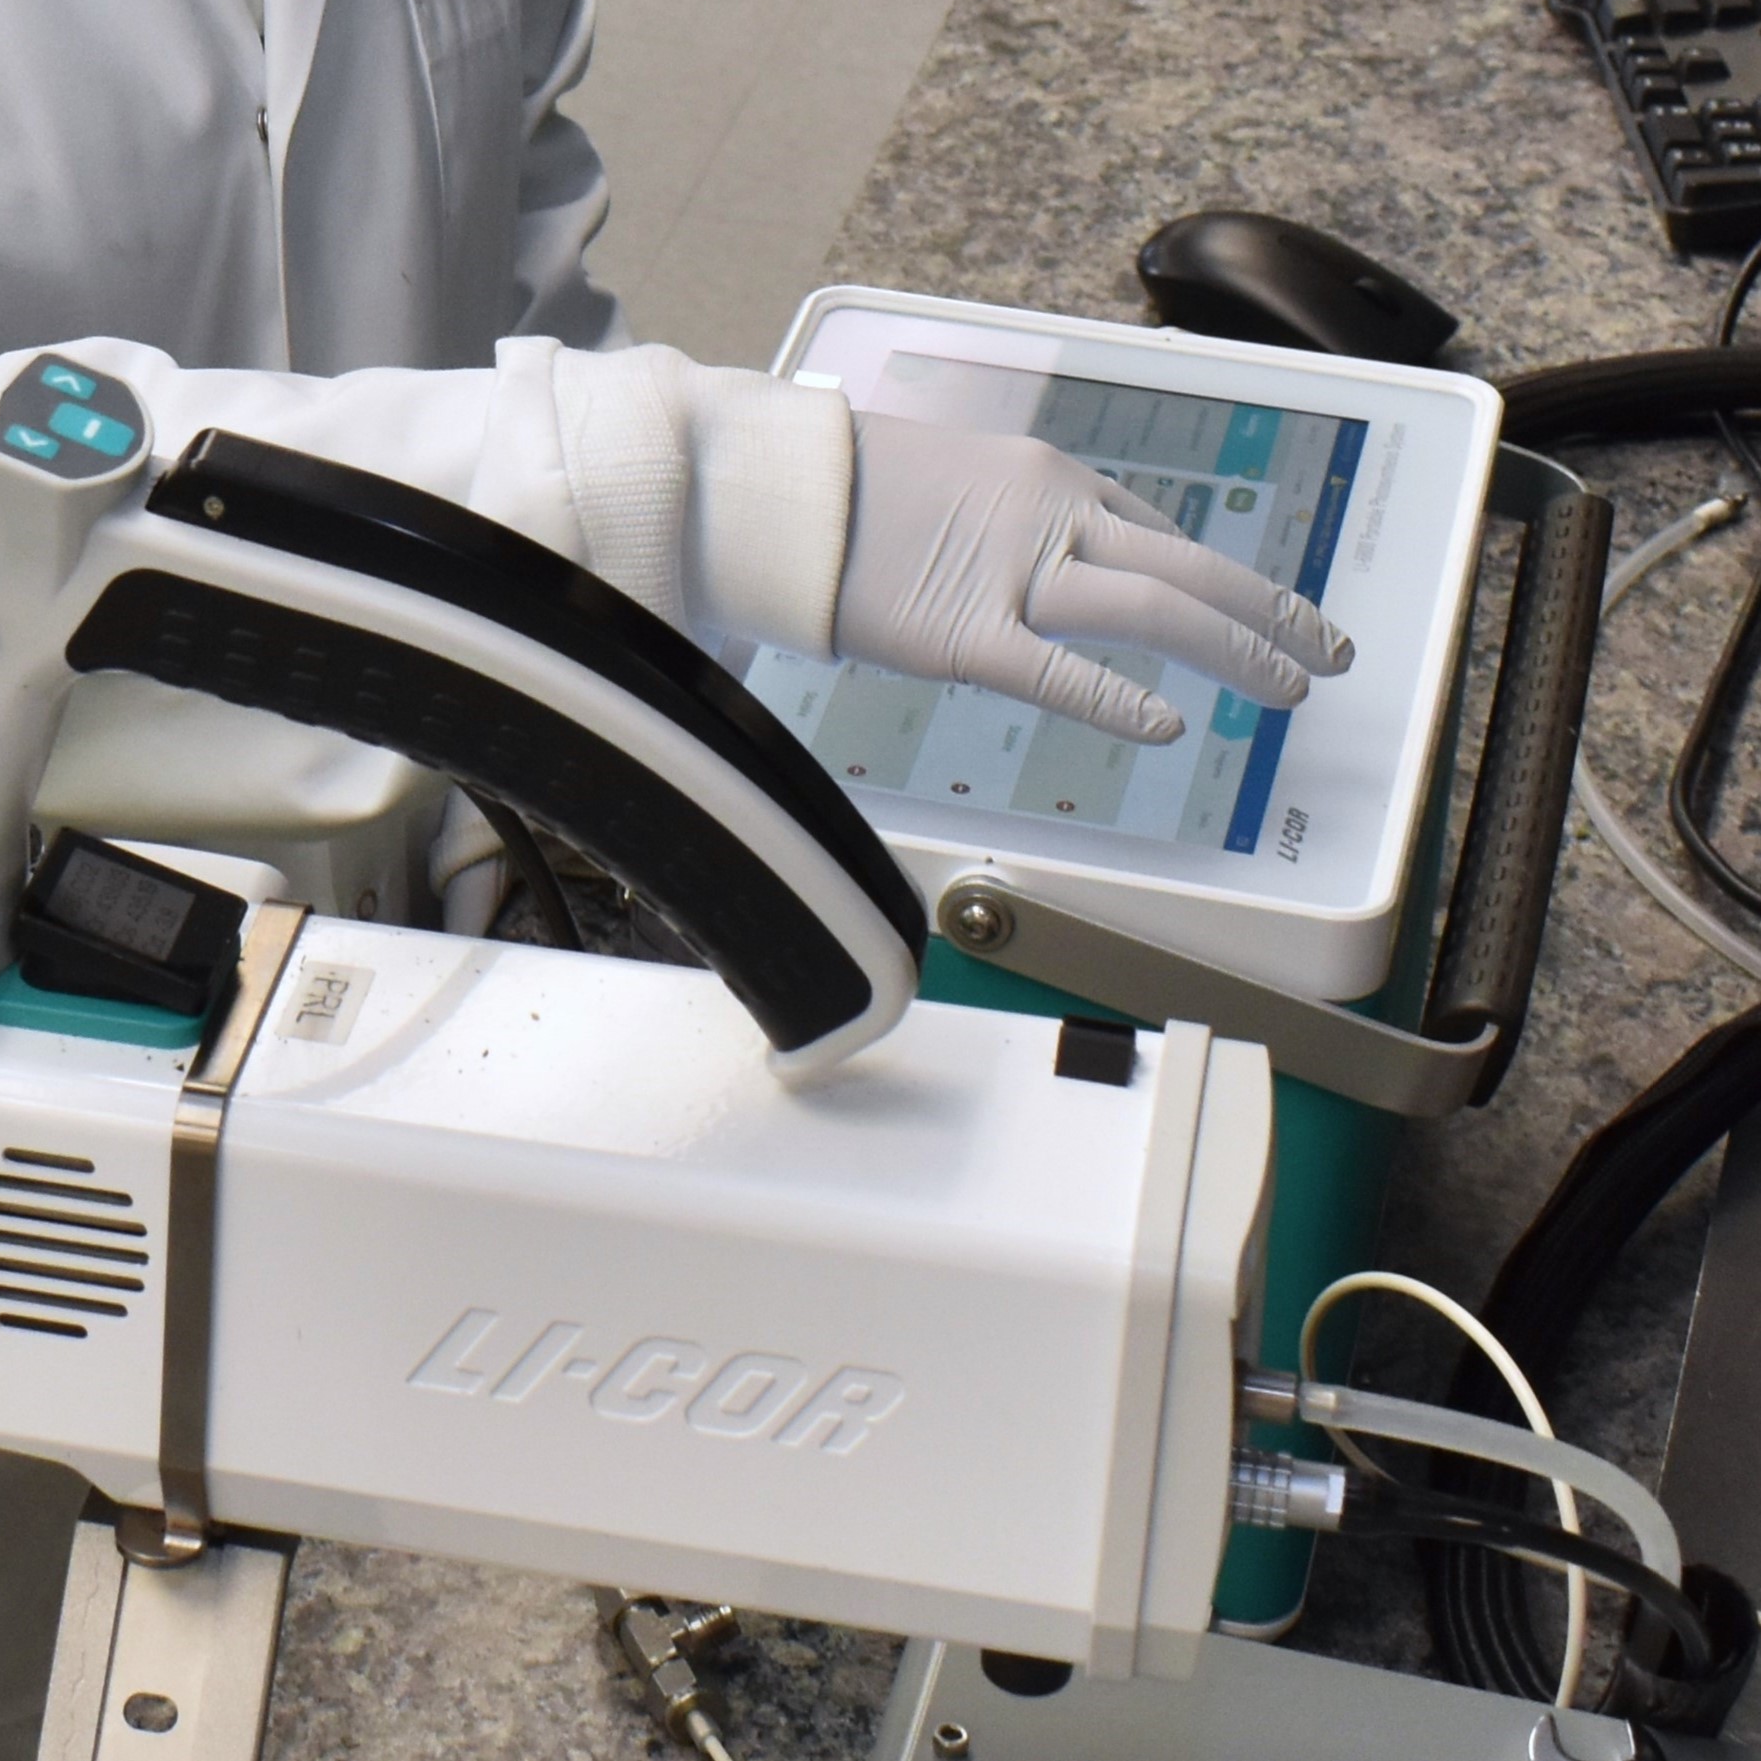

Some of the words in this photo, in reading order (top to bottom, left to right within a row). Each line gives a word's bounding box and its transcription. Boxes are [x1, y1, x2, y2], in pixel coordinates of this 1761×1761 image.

[1277, 806, 1310, 864] LI-COR
[295, 976, 351, 1024] PRL
[404, 1305, 908, 1458] LI-COR
